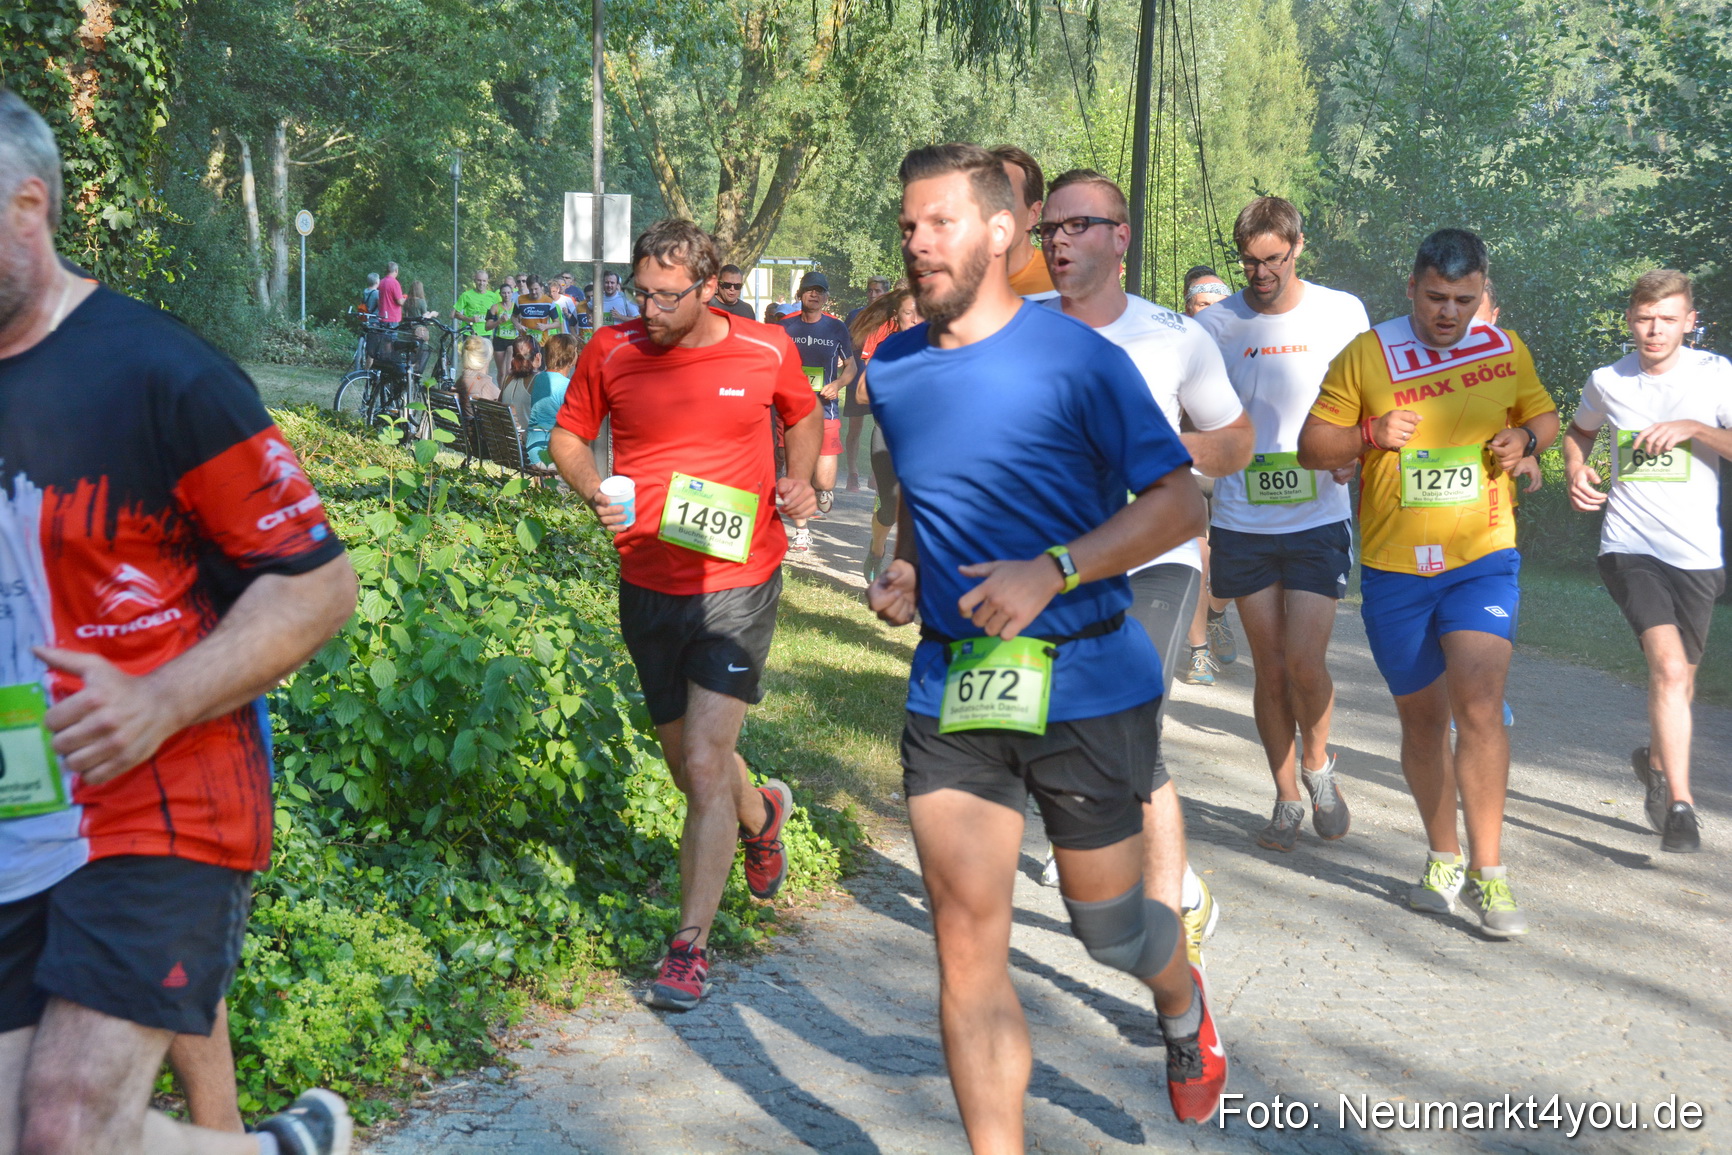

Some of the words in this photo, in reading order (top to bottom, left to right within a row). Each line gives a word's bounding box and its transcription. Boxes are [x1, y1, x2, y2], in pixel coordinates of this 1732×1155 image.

[1151, 314, 1188, 333] adidas
[791, 336, 807, 344] URO
[813, 337, 834, 347] POLES
[809, 375, 816, 384] 7
[1393, 378, 1456, 407] MAX
[1460, 362, 1516, 388] BÖGL
[1632, 449, 1673, 467] 695
[1259, 470, 1298, 490] 860
[1412, 467, 1472, 490] 1279
[678, 502, 743, 539] 1498
[958, 669, 1020, 703] 672
